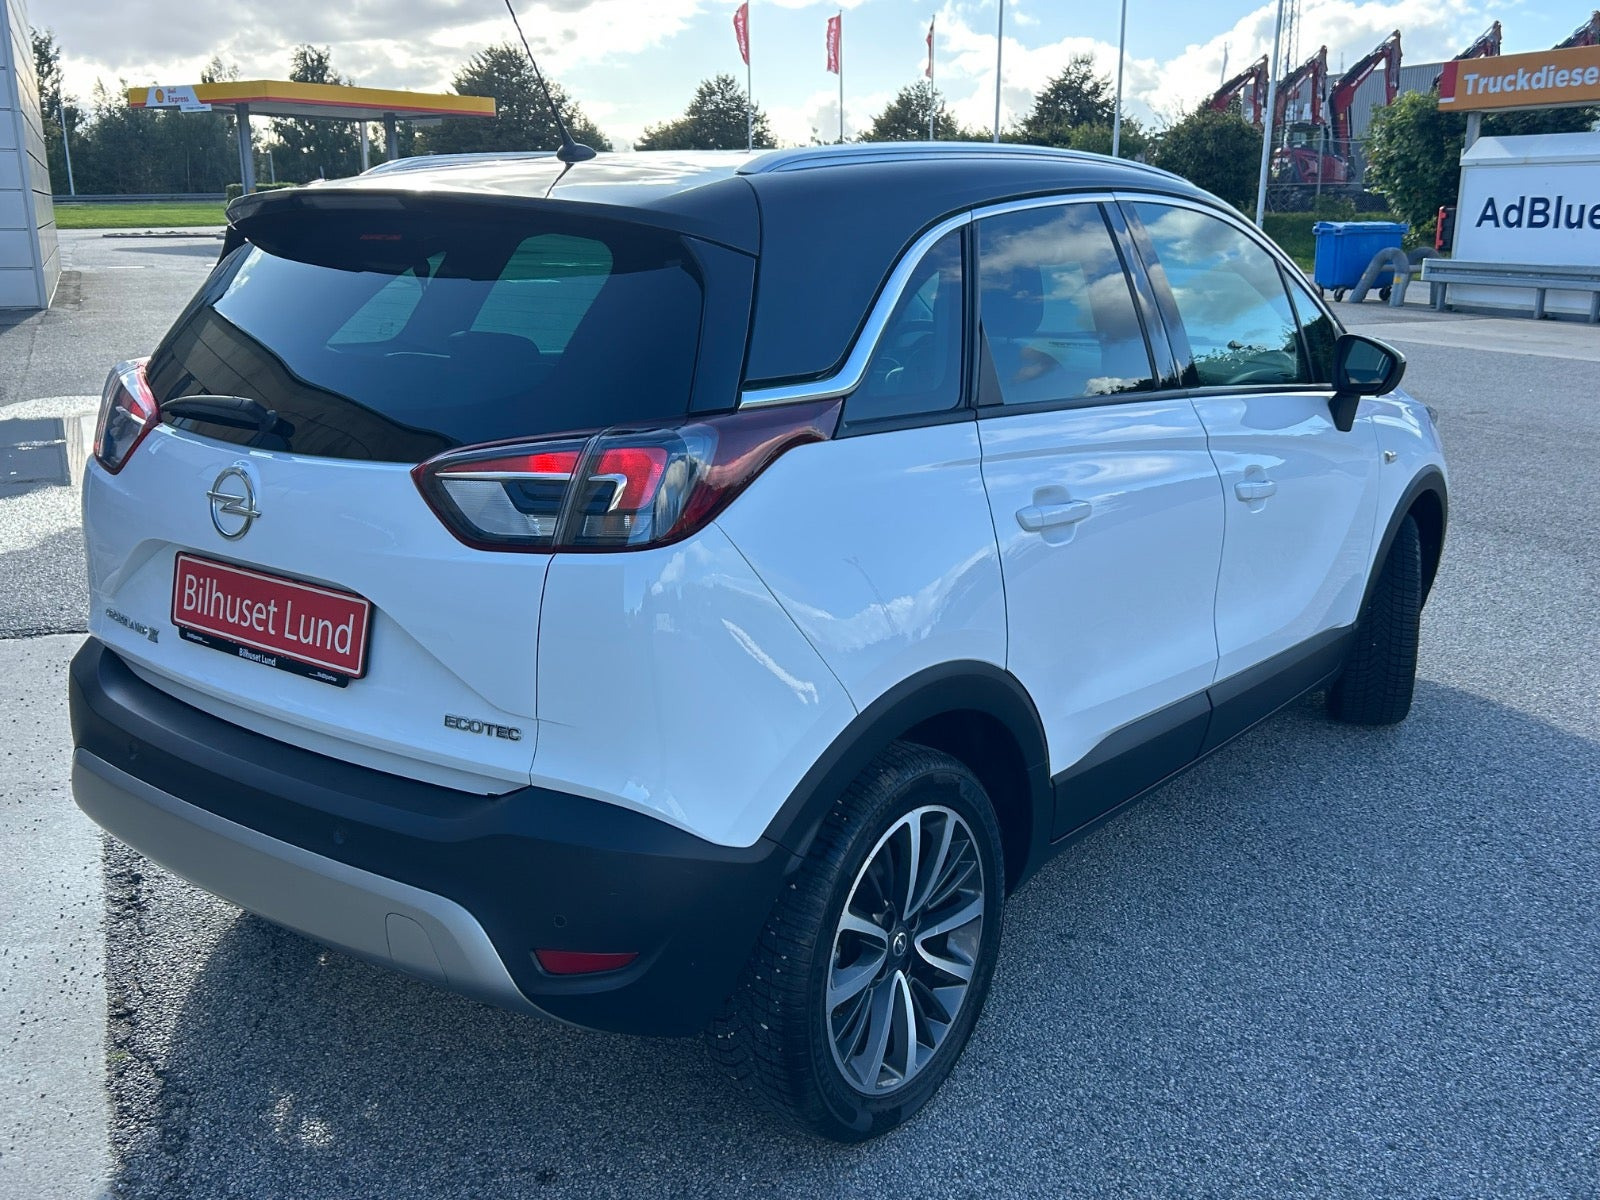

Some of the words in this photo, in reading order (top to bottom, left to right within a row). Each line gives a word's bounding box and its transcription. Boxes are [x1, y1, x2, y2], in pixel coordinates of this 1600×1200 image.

[1463, 65, 1600, 95] Truckdiese
[167, 95, 189, 104] Express
[1475, 195, 1600, 229] AdBlue
[183, 574, 278, 635] Bilhuset
[284, 600, 355, 655] Lund
[239, 647, 261, 663] Bilhuset
[261, 655, 276, 667] Lund
[444, 715, 521, 742] ECOTEC
